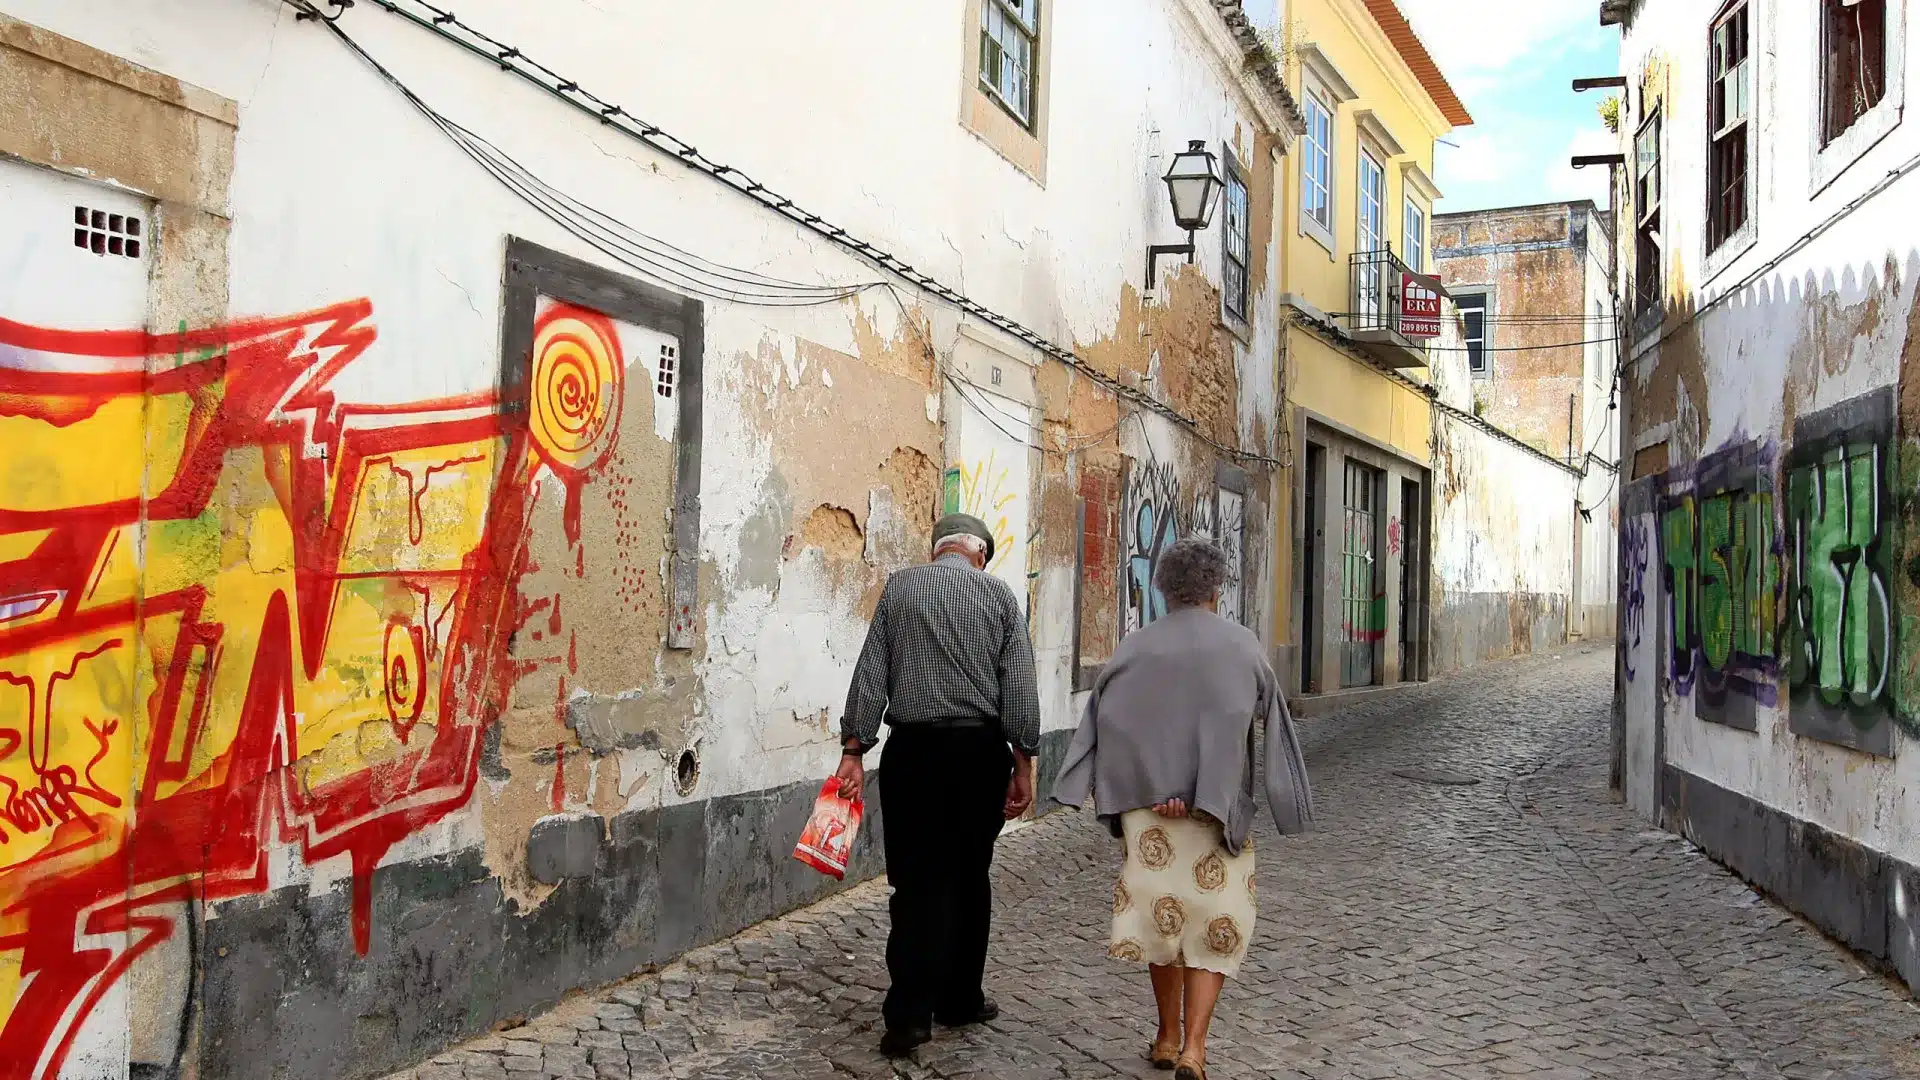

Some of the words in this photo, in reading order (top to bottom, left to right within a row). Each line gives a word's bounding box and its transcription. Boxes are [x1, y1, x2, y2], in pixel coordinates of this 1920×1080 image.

[1406, 300, 1436, 312] ERA
[1402, 323, 1415, 331] 289
[1415, 324, 1429, 332] 895
